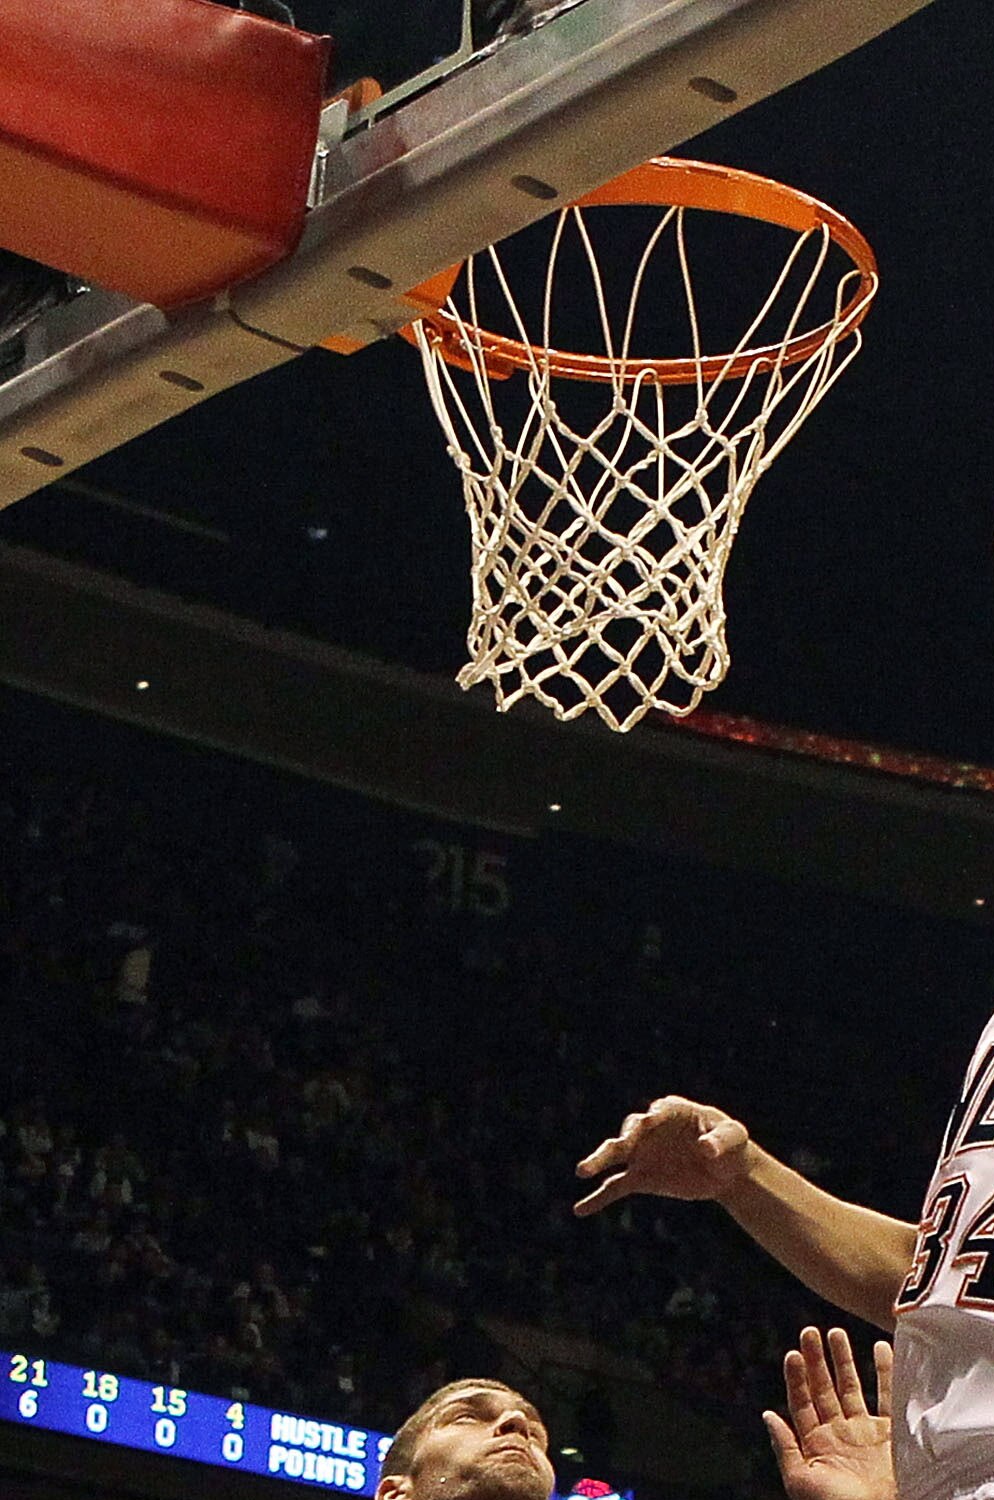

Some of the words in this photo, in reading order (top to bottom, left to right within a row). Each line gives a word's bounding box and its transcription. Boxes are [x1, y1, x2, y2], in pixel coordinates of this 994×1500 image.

[9, 1355, 48, 1387] 21
[82, 1371, 119, 1401] 18
[150, 1386, 188, 1417] 15
[226, 1402, 245, 1429] 4
[18, 1389, 38, 1418] 6
[86, 1403, 108, 1432] 0
[155, 1417, 176, 1447] 0
[222, 1432, 244, 1462] 0
[270, 1413, 367, 1459] HUSTLE
[268, 1445, 366, 1490] POINTS
